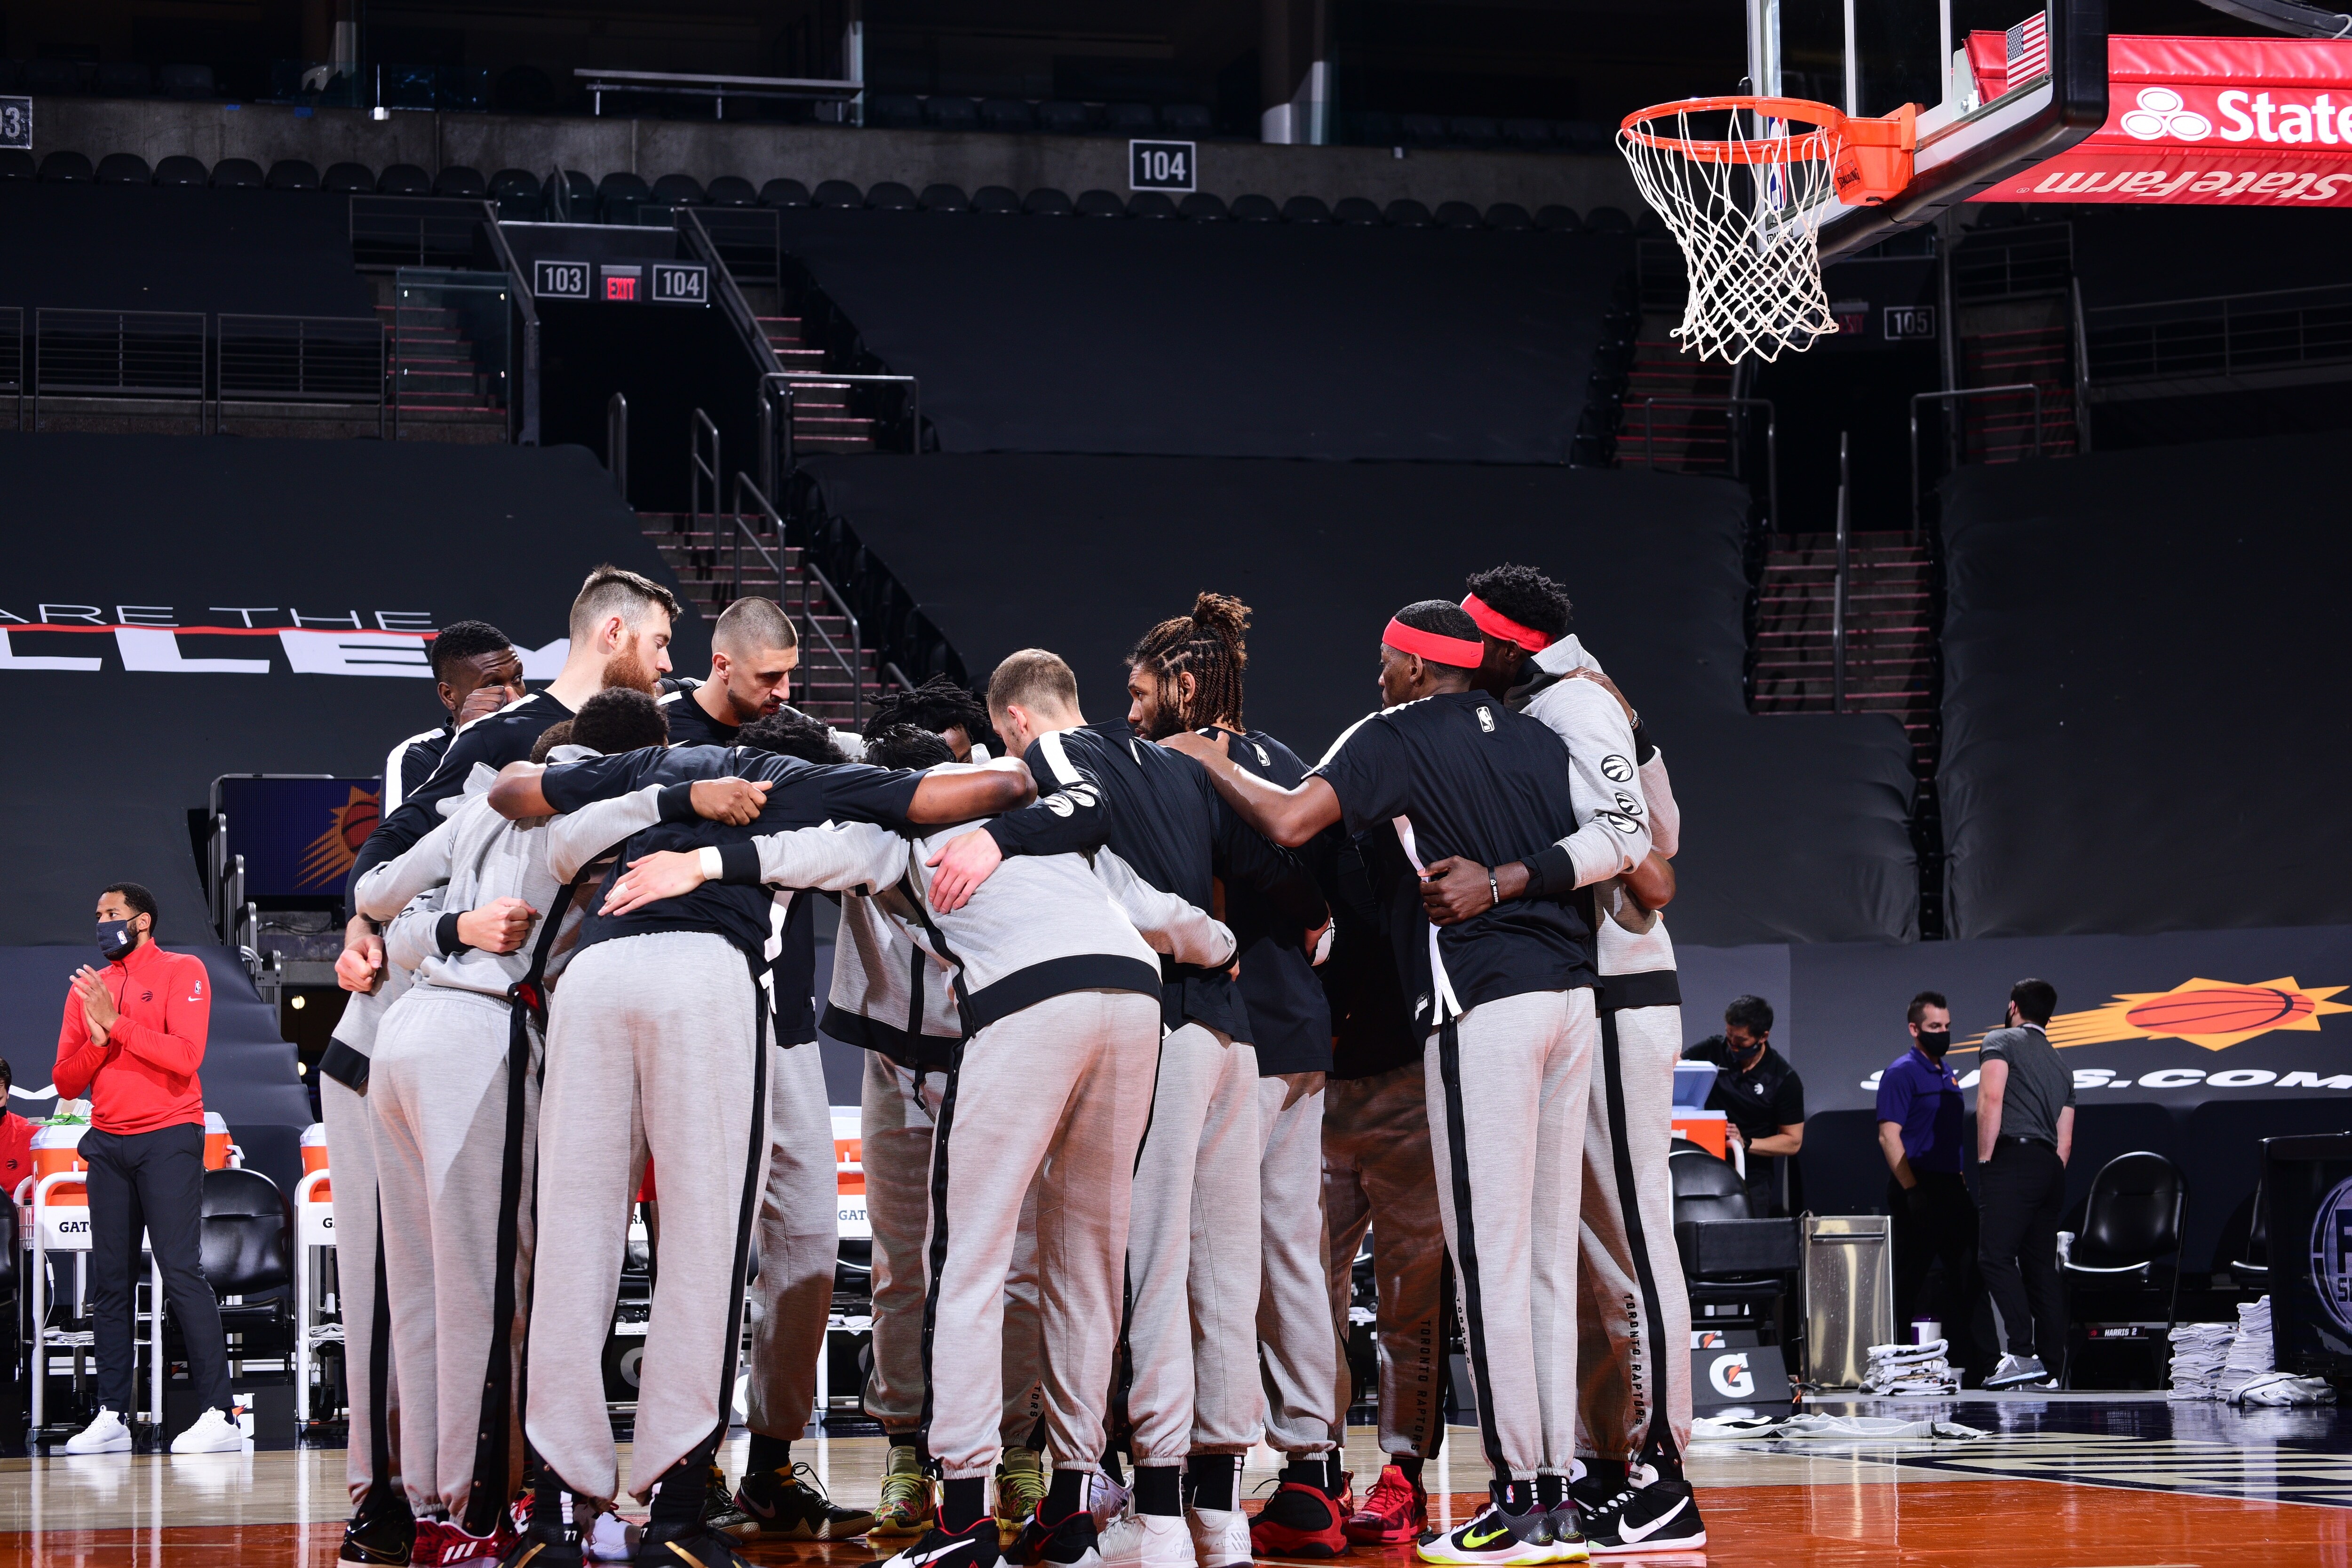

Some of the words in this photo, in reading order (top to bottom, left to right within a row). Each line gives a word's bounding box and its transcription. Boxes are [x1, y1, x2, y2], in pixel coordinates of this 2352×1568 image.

[0, 107, 20, 137] 3
[1141, 150, 1186, 181] 104
[1837, 167, 1861, 190] SPALDING
[545, 267, 581, 292] 103
[607, 277, 636, 300] EXIT
[663, 271, 699, 296] 104
[1894, 312, 1928, 334] 105
[209, 606, 439, 632] THE
[1456, 1297, 1470, 1364] TORONTO
[1624, 1293, 1640, 1355] TORONTO
[2104, 1328, 2130, 1337] HARRIS
[2131, 1327, 2137, 1336] 2
[1418, 1320, 1431, 1382] TORONTO
[1030, 1378, 1041, 1417] TORS
[1631, 1364, 1646, 1425] RAPTORS
[1410, 1390, 1428, 1451] RAPTORS
[564, 1530, 578, 1541] 77
